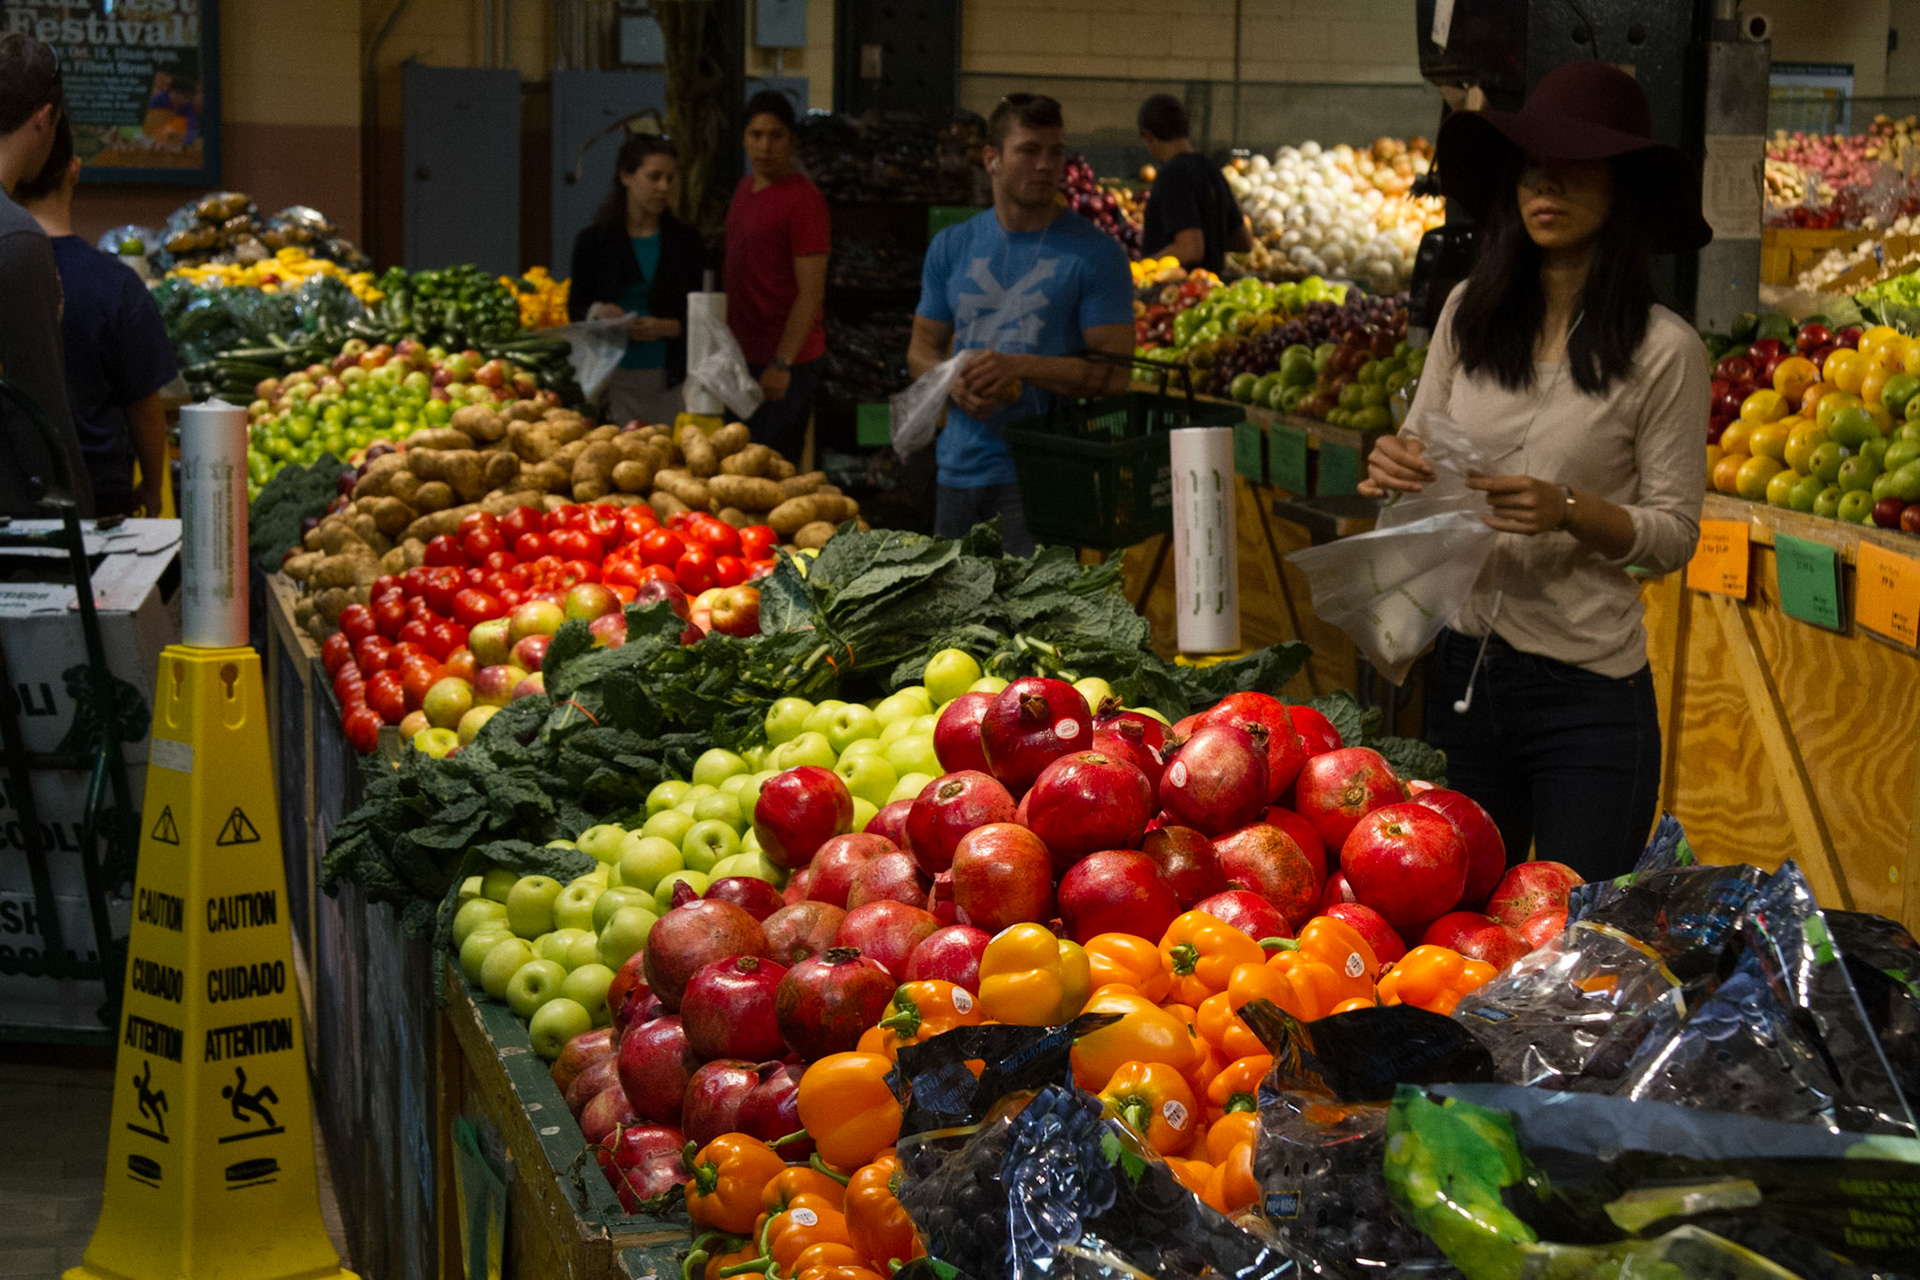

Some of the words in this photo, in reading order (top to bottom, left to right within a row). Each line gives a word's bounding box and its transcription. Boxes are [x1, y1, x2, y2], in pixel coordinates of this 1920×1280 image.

[5, 8, 200, 47] Festival
[137, 887, 184, 933] CAUTION
[207, 889, 277, 934] CAUTION
[132, 956, 184, 1004] CUIDADO
[207, 960, 286, 1005] CUIDADO
[124, 1014, 184, 1064] ATTENTION
[204, 1017, 293, 1063] ATTENTION
